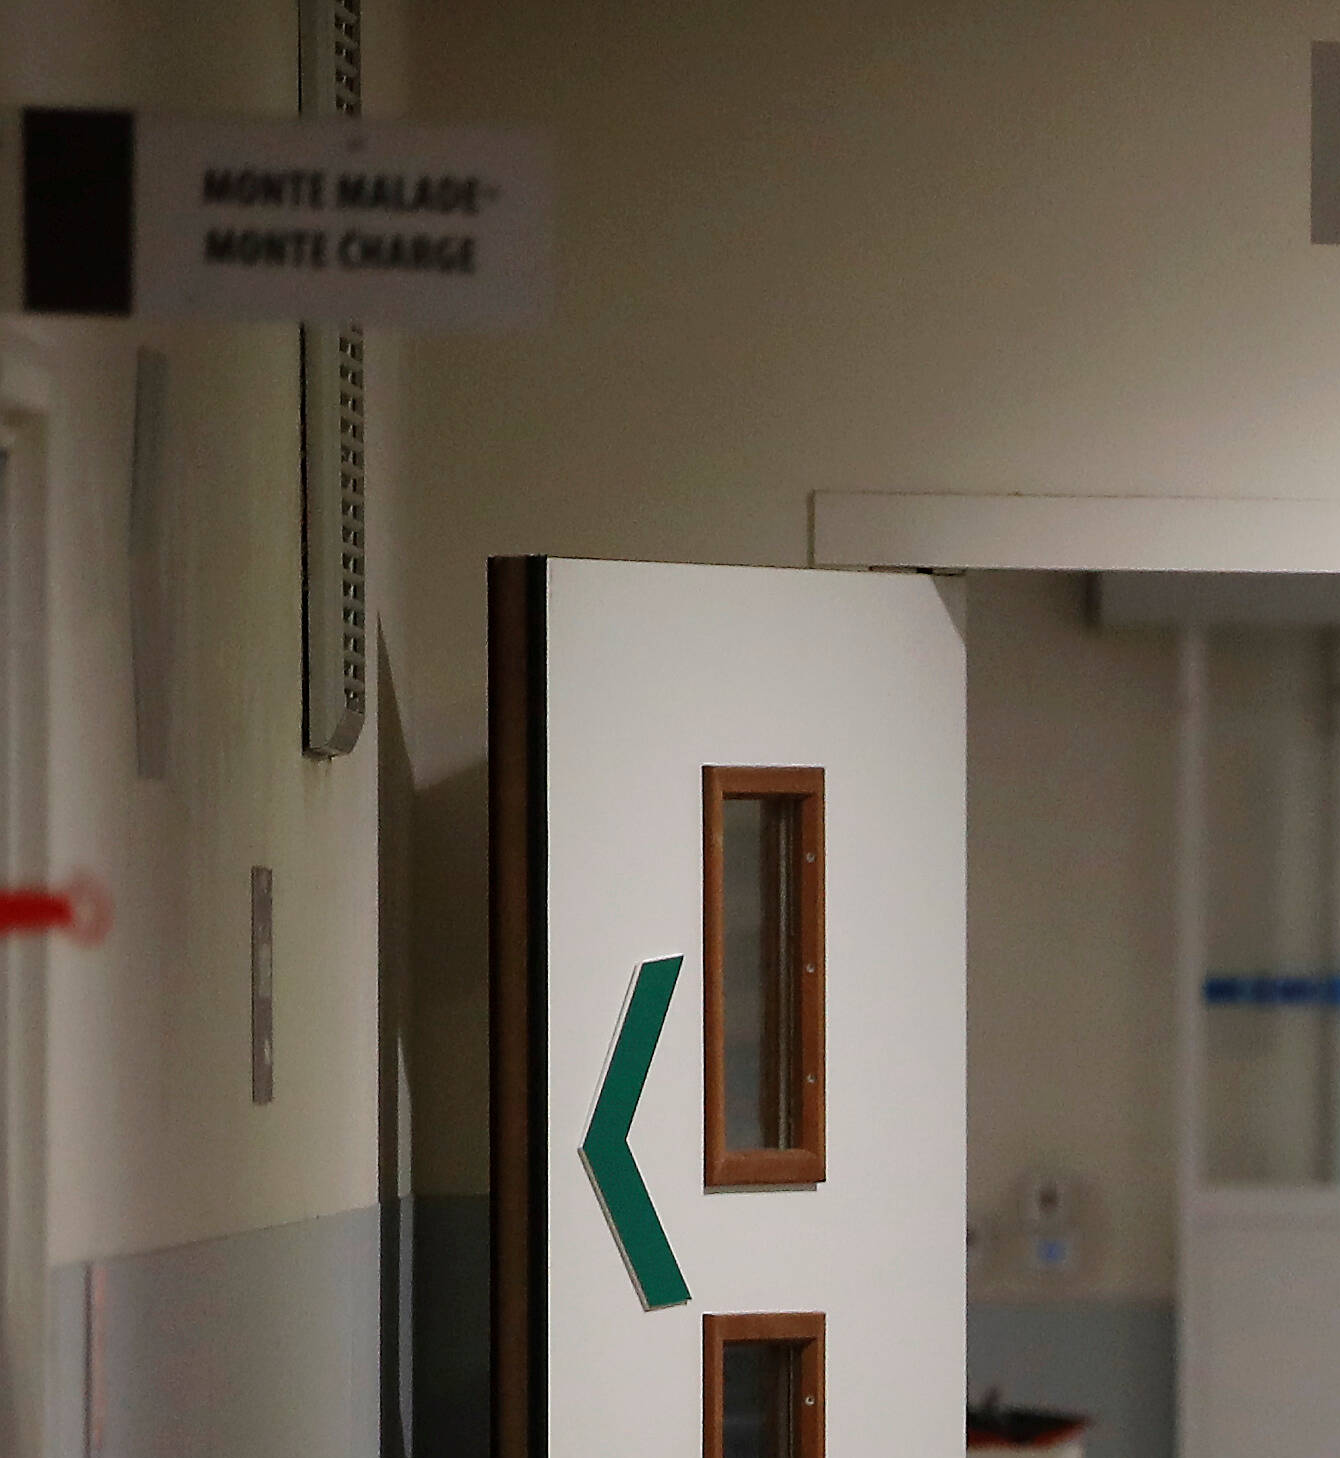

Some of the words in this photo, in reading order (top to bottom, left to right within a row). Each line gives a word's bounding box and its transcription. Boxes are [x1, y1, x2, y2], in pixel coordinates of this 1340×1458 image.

[203, 168, 324, 209] MONTE
[203, 228, 326, 269] MONTE
[336, 230, 477, 274] CHARGE
